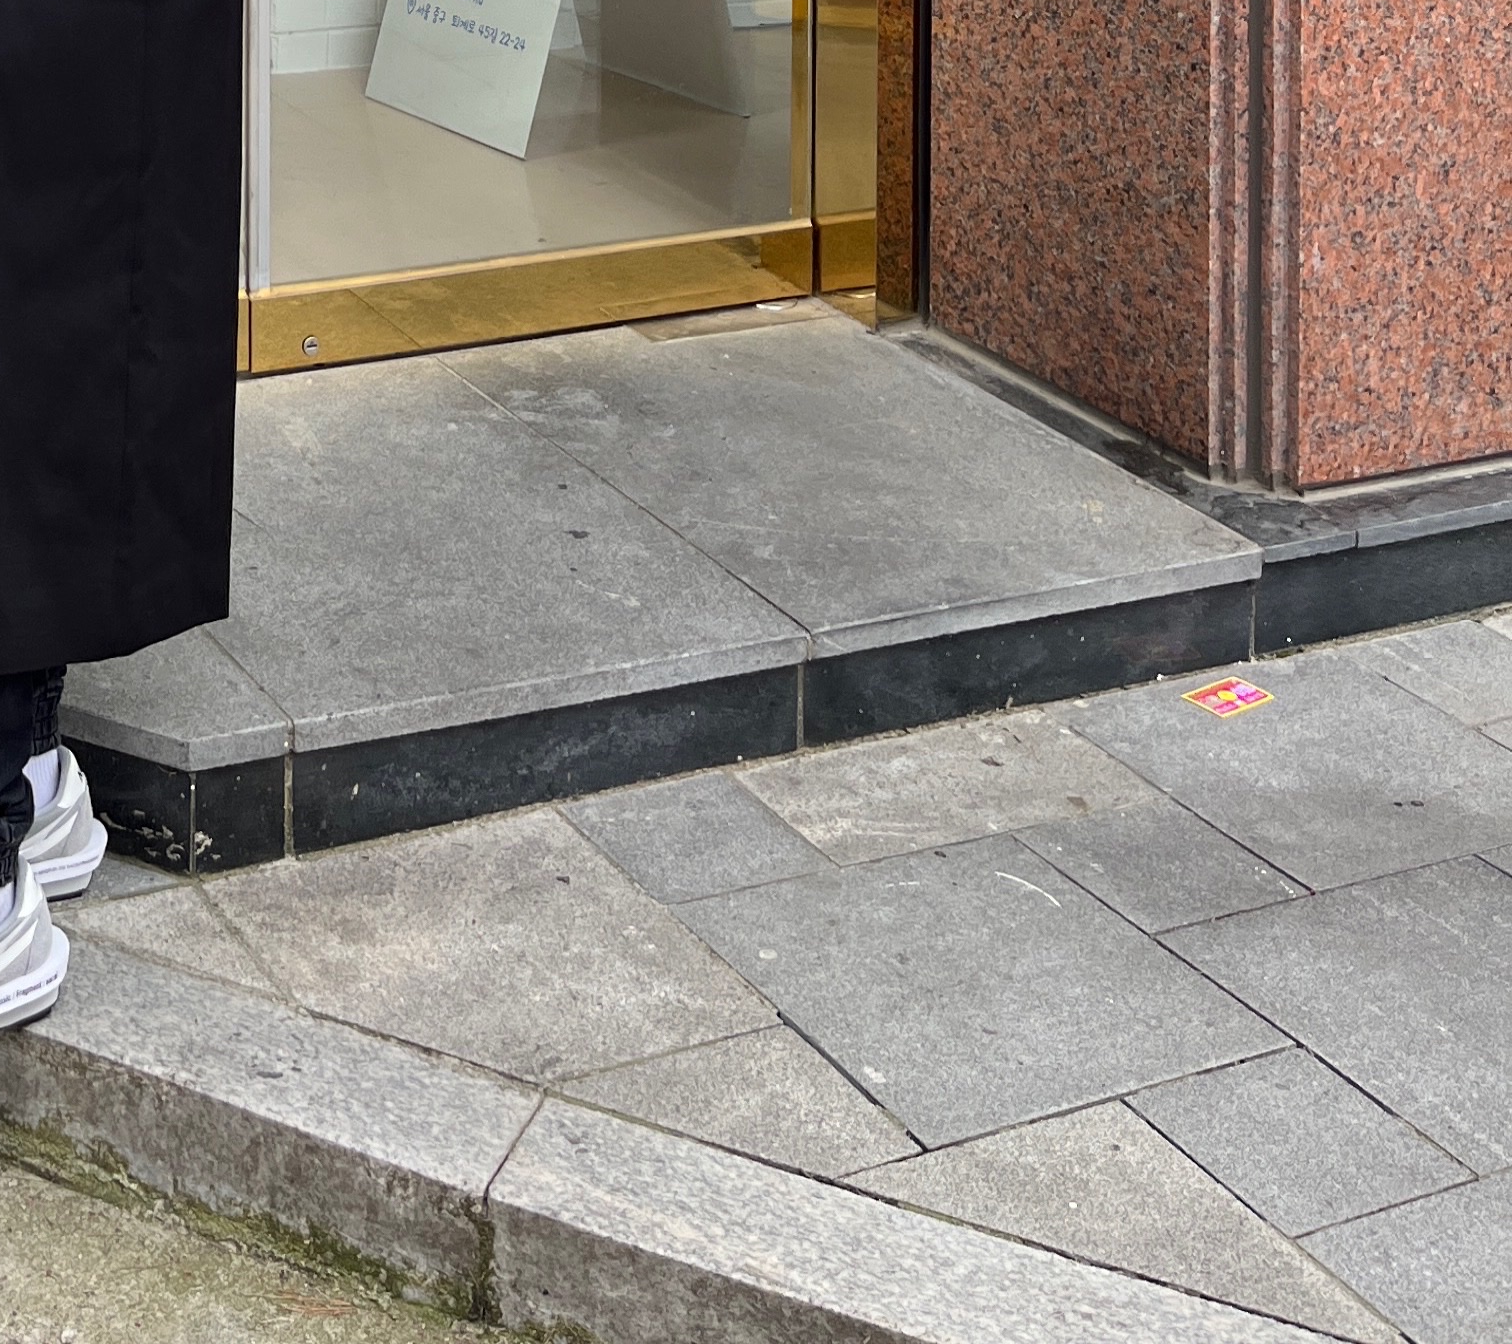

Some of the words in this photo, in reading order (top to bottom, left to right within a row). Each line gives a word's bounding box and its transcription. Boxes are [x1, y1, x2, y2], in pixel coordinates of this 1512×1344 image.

[415, 5, 432, 22] 서울
[432, 6, 447, 25] 중구
[451, 13, 477, 35] 퇴계로
[478, 23, 499, 45] 45길
[499, 30, 528, 52] 22-24
